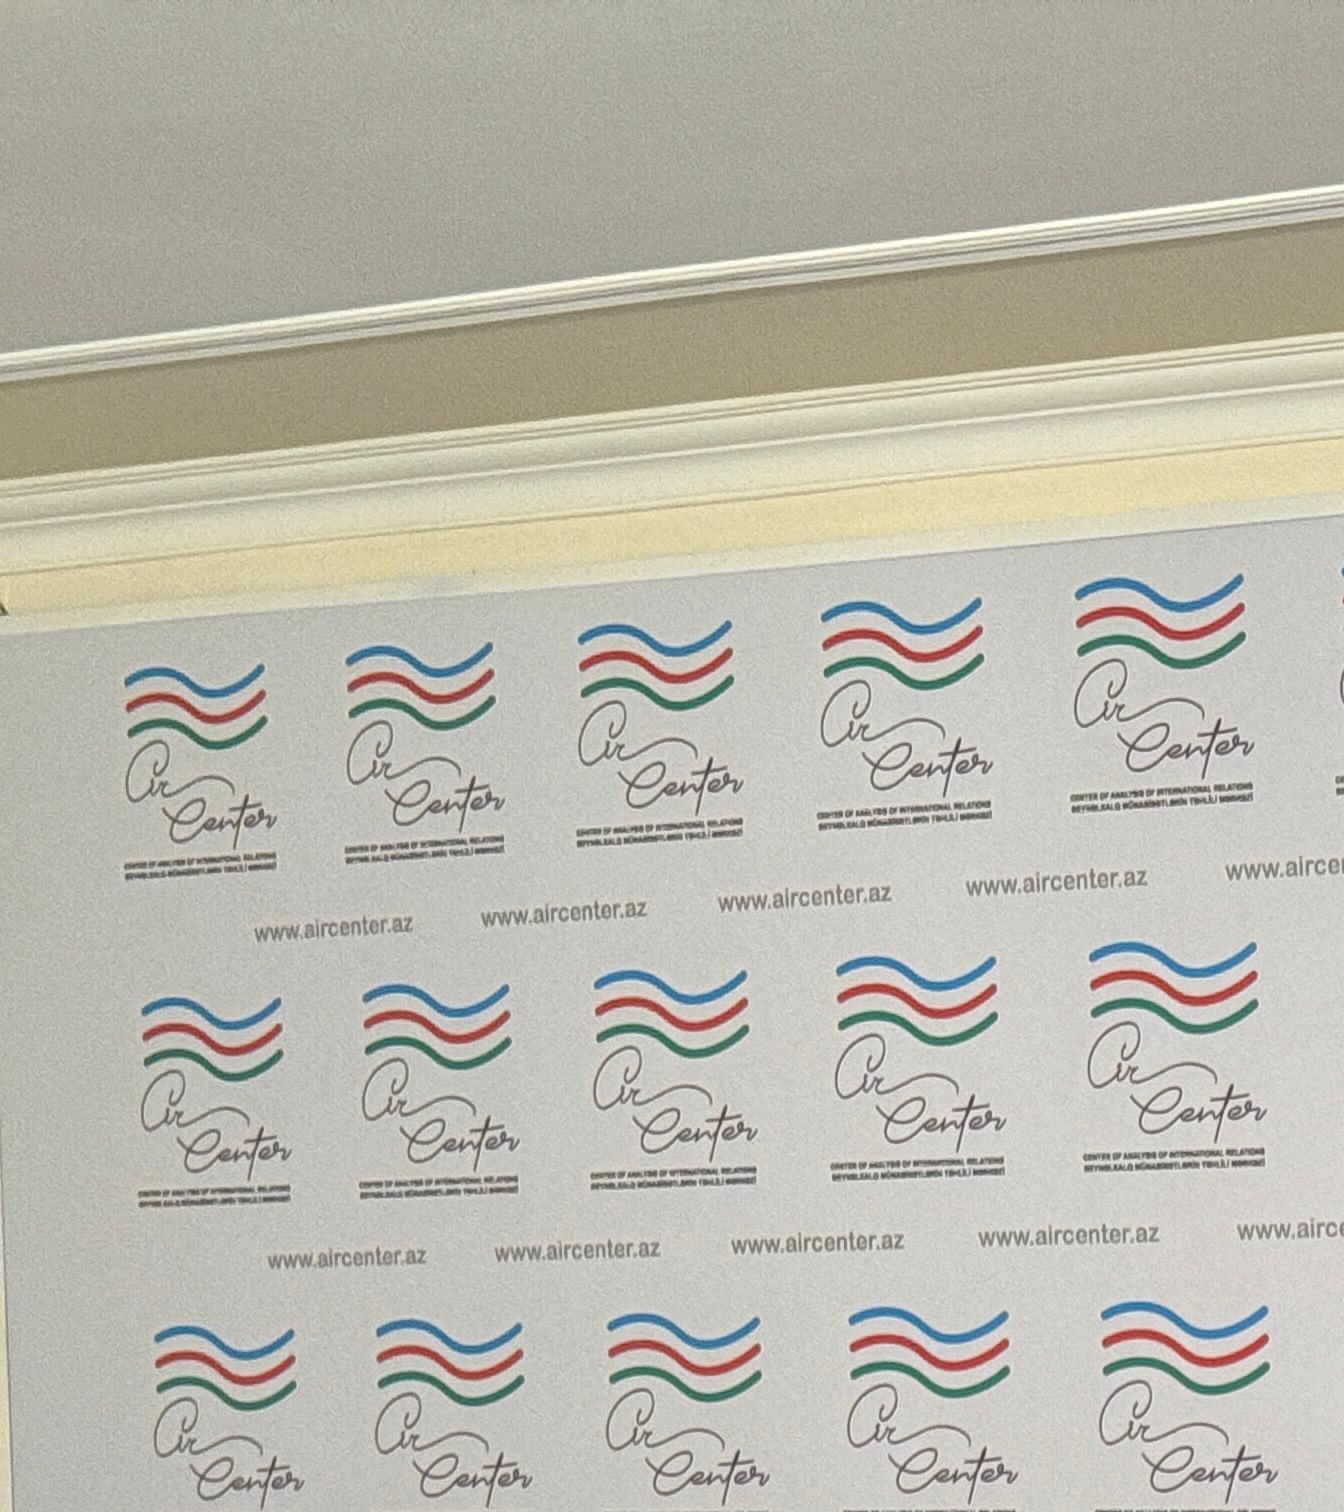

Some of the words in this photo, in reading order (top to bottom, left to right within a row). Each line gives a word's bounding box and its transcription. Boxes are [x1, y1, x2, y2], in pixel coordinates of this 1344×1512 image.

[861, 737, 994, 798] Center
[384, 775, 505, 833] Center
[966, 868, 1148, 896] www.aircenter.az
[717, 884, 892, 913] www.aircenter.az
[481, 900, 648, 928] www.aircenter.az
[254, 915, 413, 943] www.aircenter.az
[1129, 1083, 1267, 1144] Center
[632, 1104, 758, 1163] Center
[176, 1126, 292, 1182] Center
[731, 1231, 904, 1255] www.aircenter.az
[978, 1223, 1160, 1248] www.aircenter.az
[268, 1246, 426, 1269] www.aircenter.az
[494, 1239, 661, 1262] www.aircenter.az
[412, 1451, 533, 1508] Center
[888, 1446, 1019, 1505] Center
